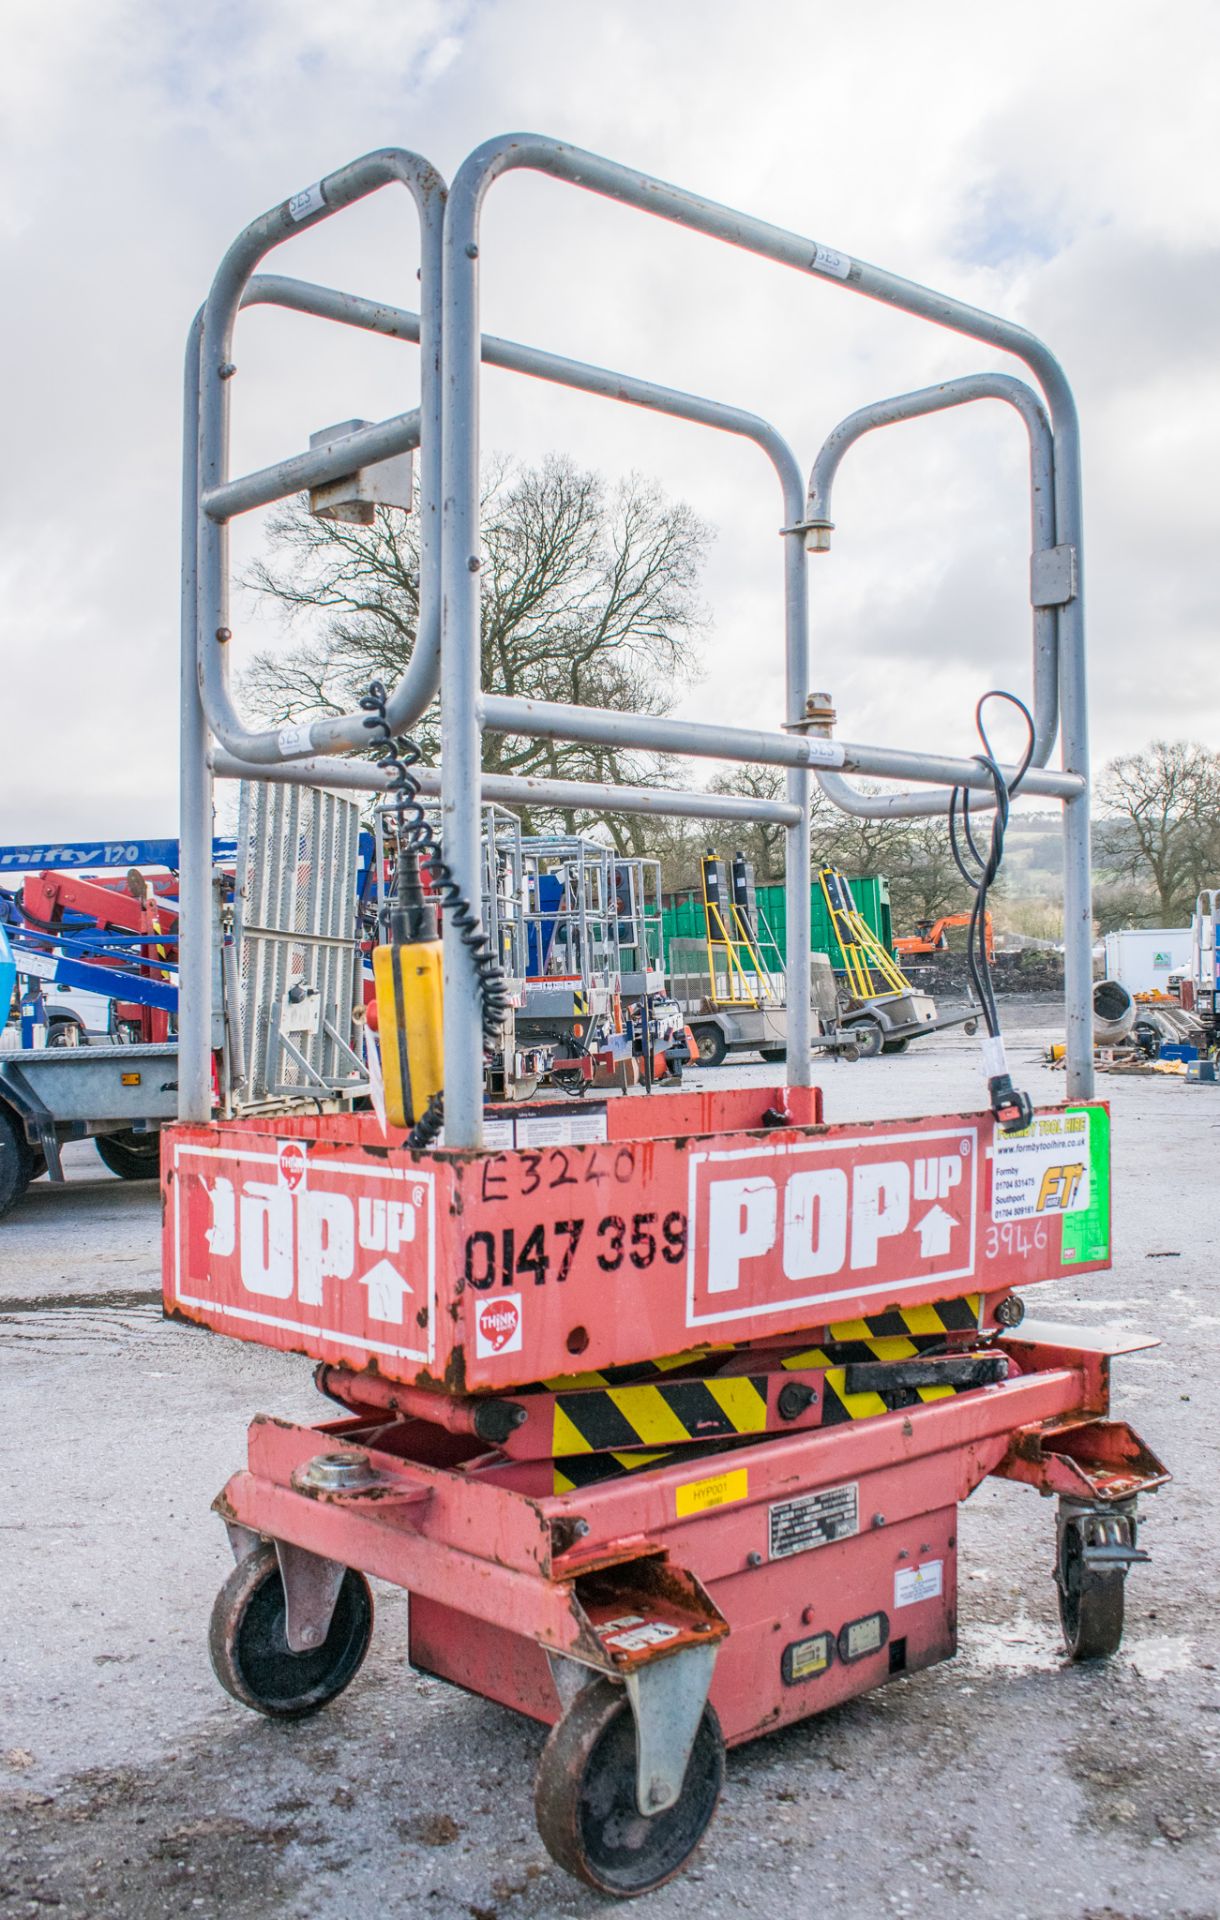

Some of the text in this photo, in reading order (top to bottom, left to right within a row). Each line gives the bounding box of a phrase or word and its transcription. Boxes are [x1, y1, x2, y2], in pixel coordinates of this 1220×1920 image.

[0, 849, 102, 864] nifty
[1039, 1119, 1063, 1136] TOOL
[1064, 1116, 1086, 1133] HIRE
[997, 1137, 1086, 1155] www.formbytoolhire.co.uk
[995, 1167, 1019, 1177] Formby
[995, 1194, 1025, 1205] Southport
[358, 1196, 416, 1254] UP
[707, 1155, 962, 1293] POP UP
[596, 1210, 688, 1272] 359
[985, 1219, 1048, 1259] 3946
